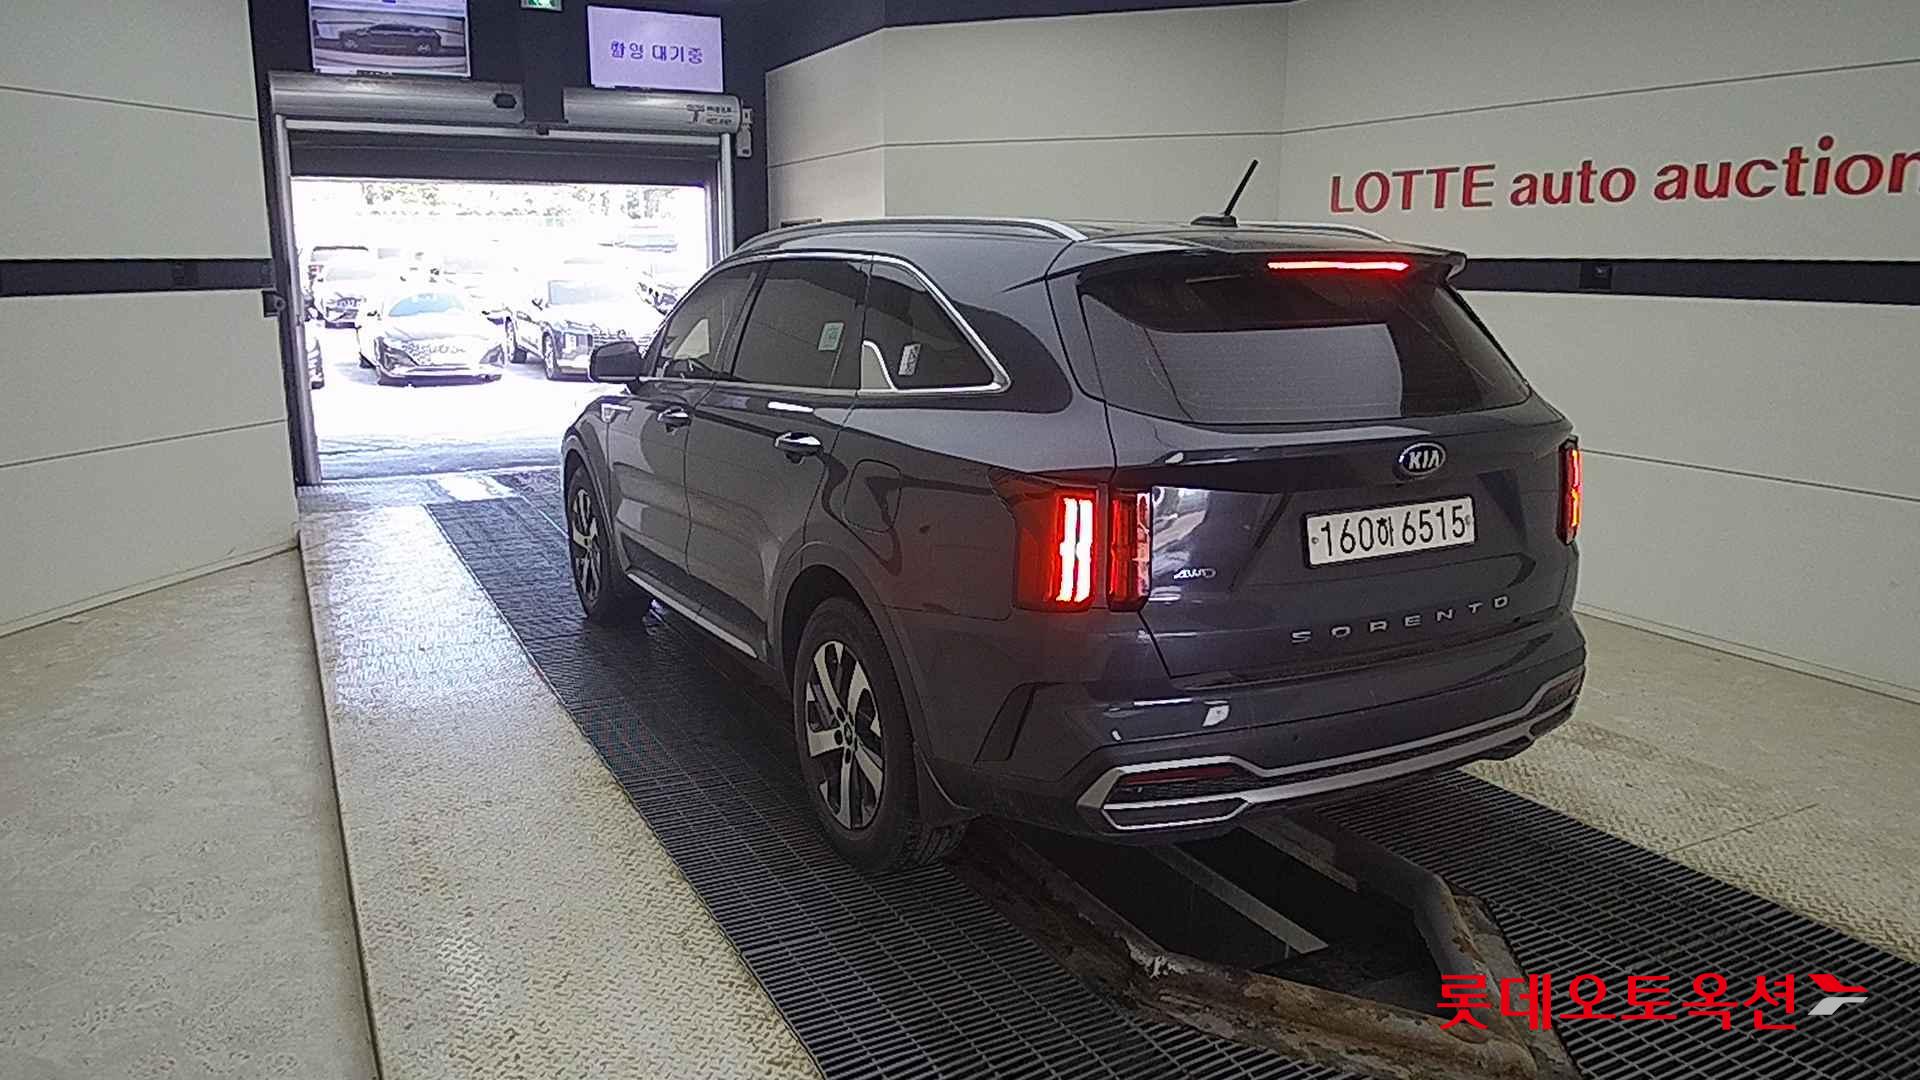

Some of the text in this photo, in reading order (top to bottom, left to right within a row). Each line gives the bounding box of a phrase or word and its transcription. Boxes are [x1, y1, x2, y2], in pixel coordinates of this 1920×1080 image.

[651, 44, 703, 65] 대기중
[1329, 164, 1496, 213] LOTTE
[1508, 159, 1637, 208] auto
[1408, 449, 1442, 471] KIA
[1290, 595, 1511, 645] SORENTO
